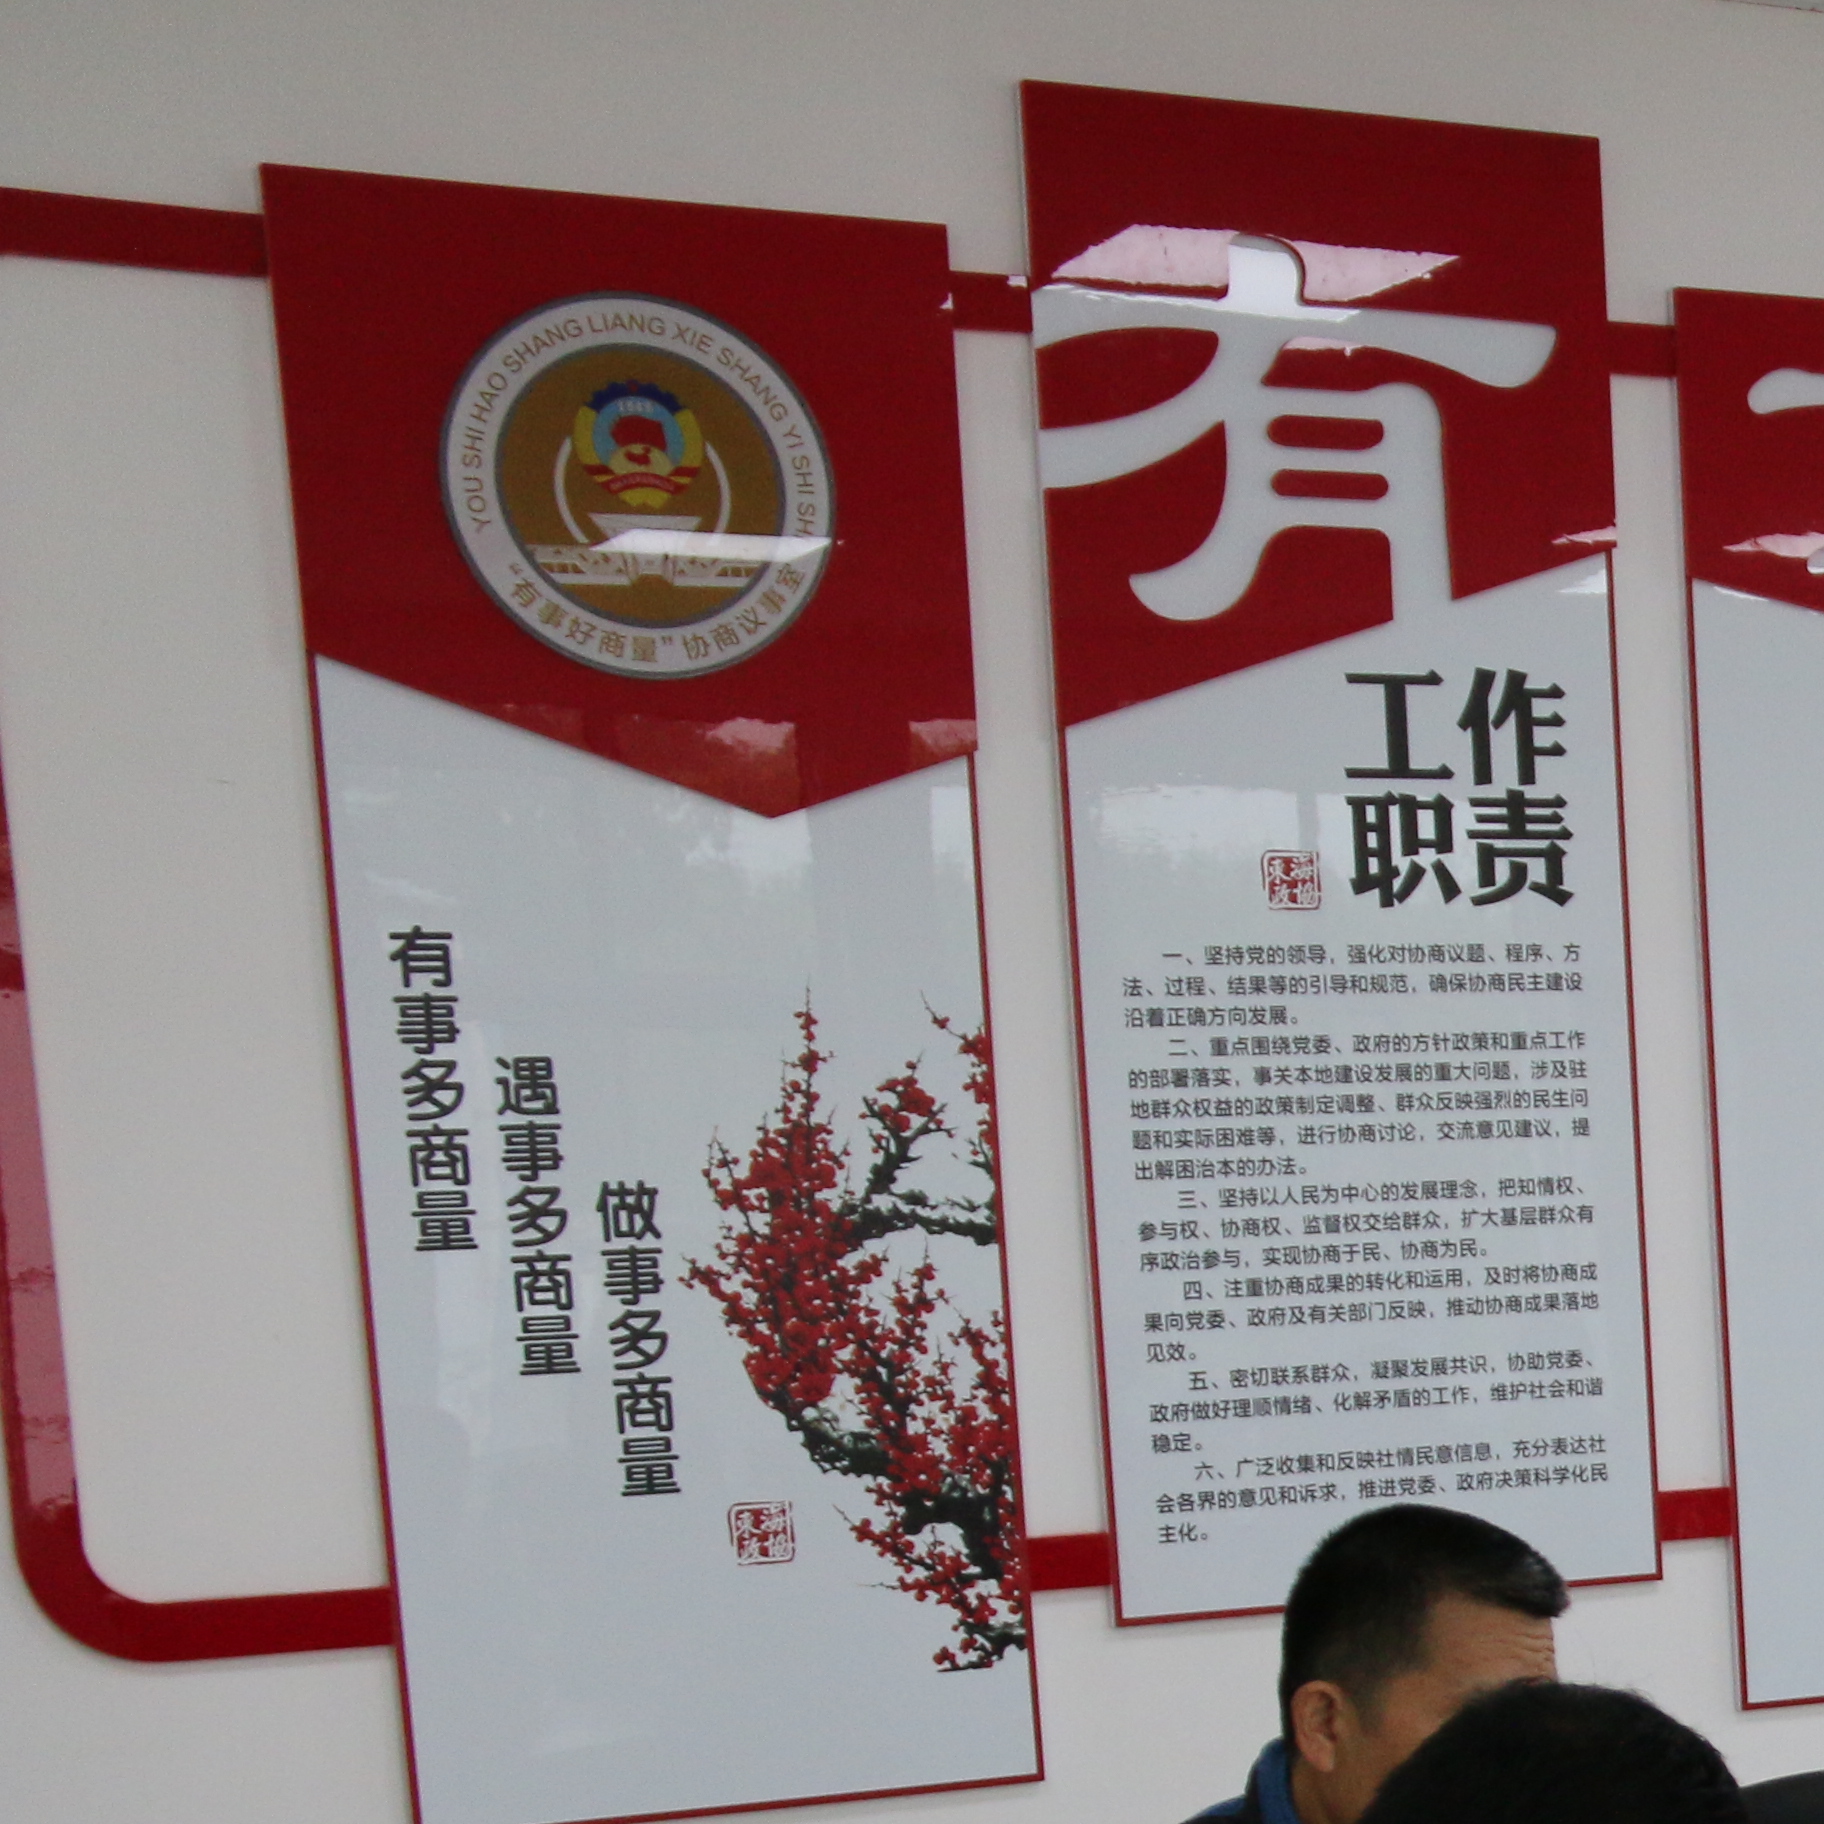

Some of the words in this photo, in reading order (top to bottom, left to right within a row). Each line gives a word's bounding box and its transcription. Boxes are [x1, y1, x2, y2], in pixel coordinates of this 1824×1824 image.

[587, 312, 666, 336] LIANG
[672, 325, 714, 353] XIE
[504, 318, 584, 374] SHANG
[473, 372, 508, 424] HAO
[716, 347, 788, 423] SHANG
[462, 429, 485, 469] SHI
[783, 423, 806, 450] YI
[791, 454, 815, 496] SHI
[463, 476, 492, 534] YOU
[796, 504, 820, 540] SH
[1343, 667, 1567, 785] 工作
[1343, 791, 1574, 909] 职责
[1124, 1005, 1298, 1028] 沿着正确方向发展。
[390, 925, 478, 1253] 有事多商量
[1134, 1156, 1307, 1181] 出解困治本的办法。
[494, 1055, 581, 1377] 遇事多商量
[596, 1180, 682, 1497] 做事多商量
[1146, 1342, 1197, 1363] 见效。
[1150, 1432, 1203, 1454] 稳定。
[1157, 1523, 1209, 1544] 主化。
